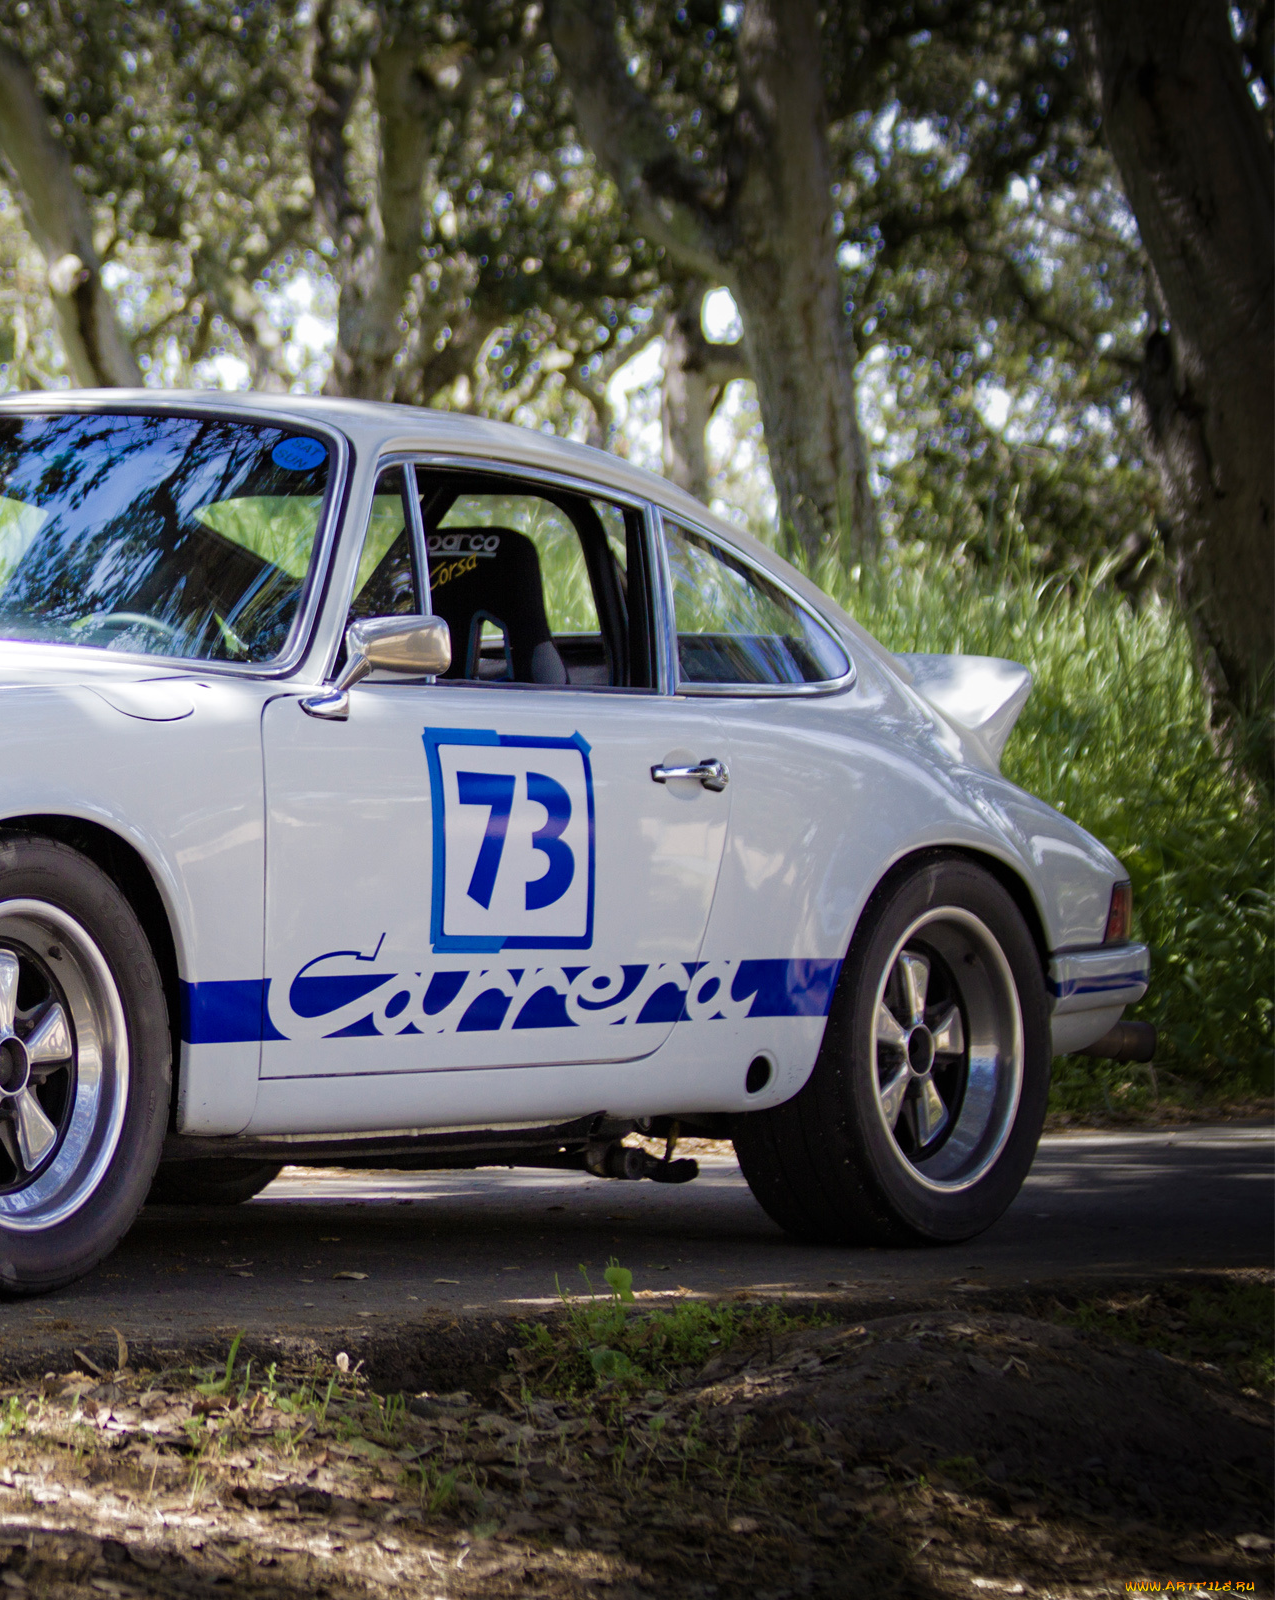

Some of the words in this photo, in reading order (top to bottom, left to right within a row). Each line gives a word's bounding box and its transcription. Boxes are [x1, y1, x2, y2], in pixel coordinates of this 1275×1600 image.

[275, 449, 308, 468] SUN
[291, 438, 322, 456] SAT
[426, 534, 500, 552] parco
[456, 771, 575, 910] 73
[99, 892, 154, 989] TOYO
[268, 932, 758, 1041] Carrera
